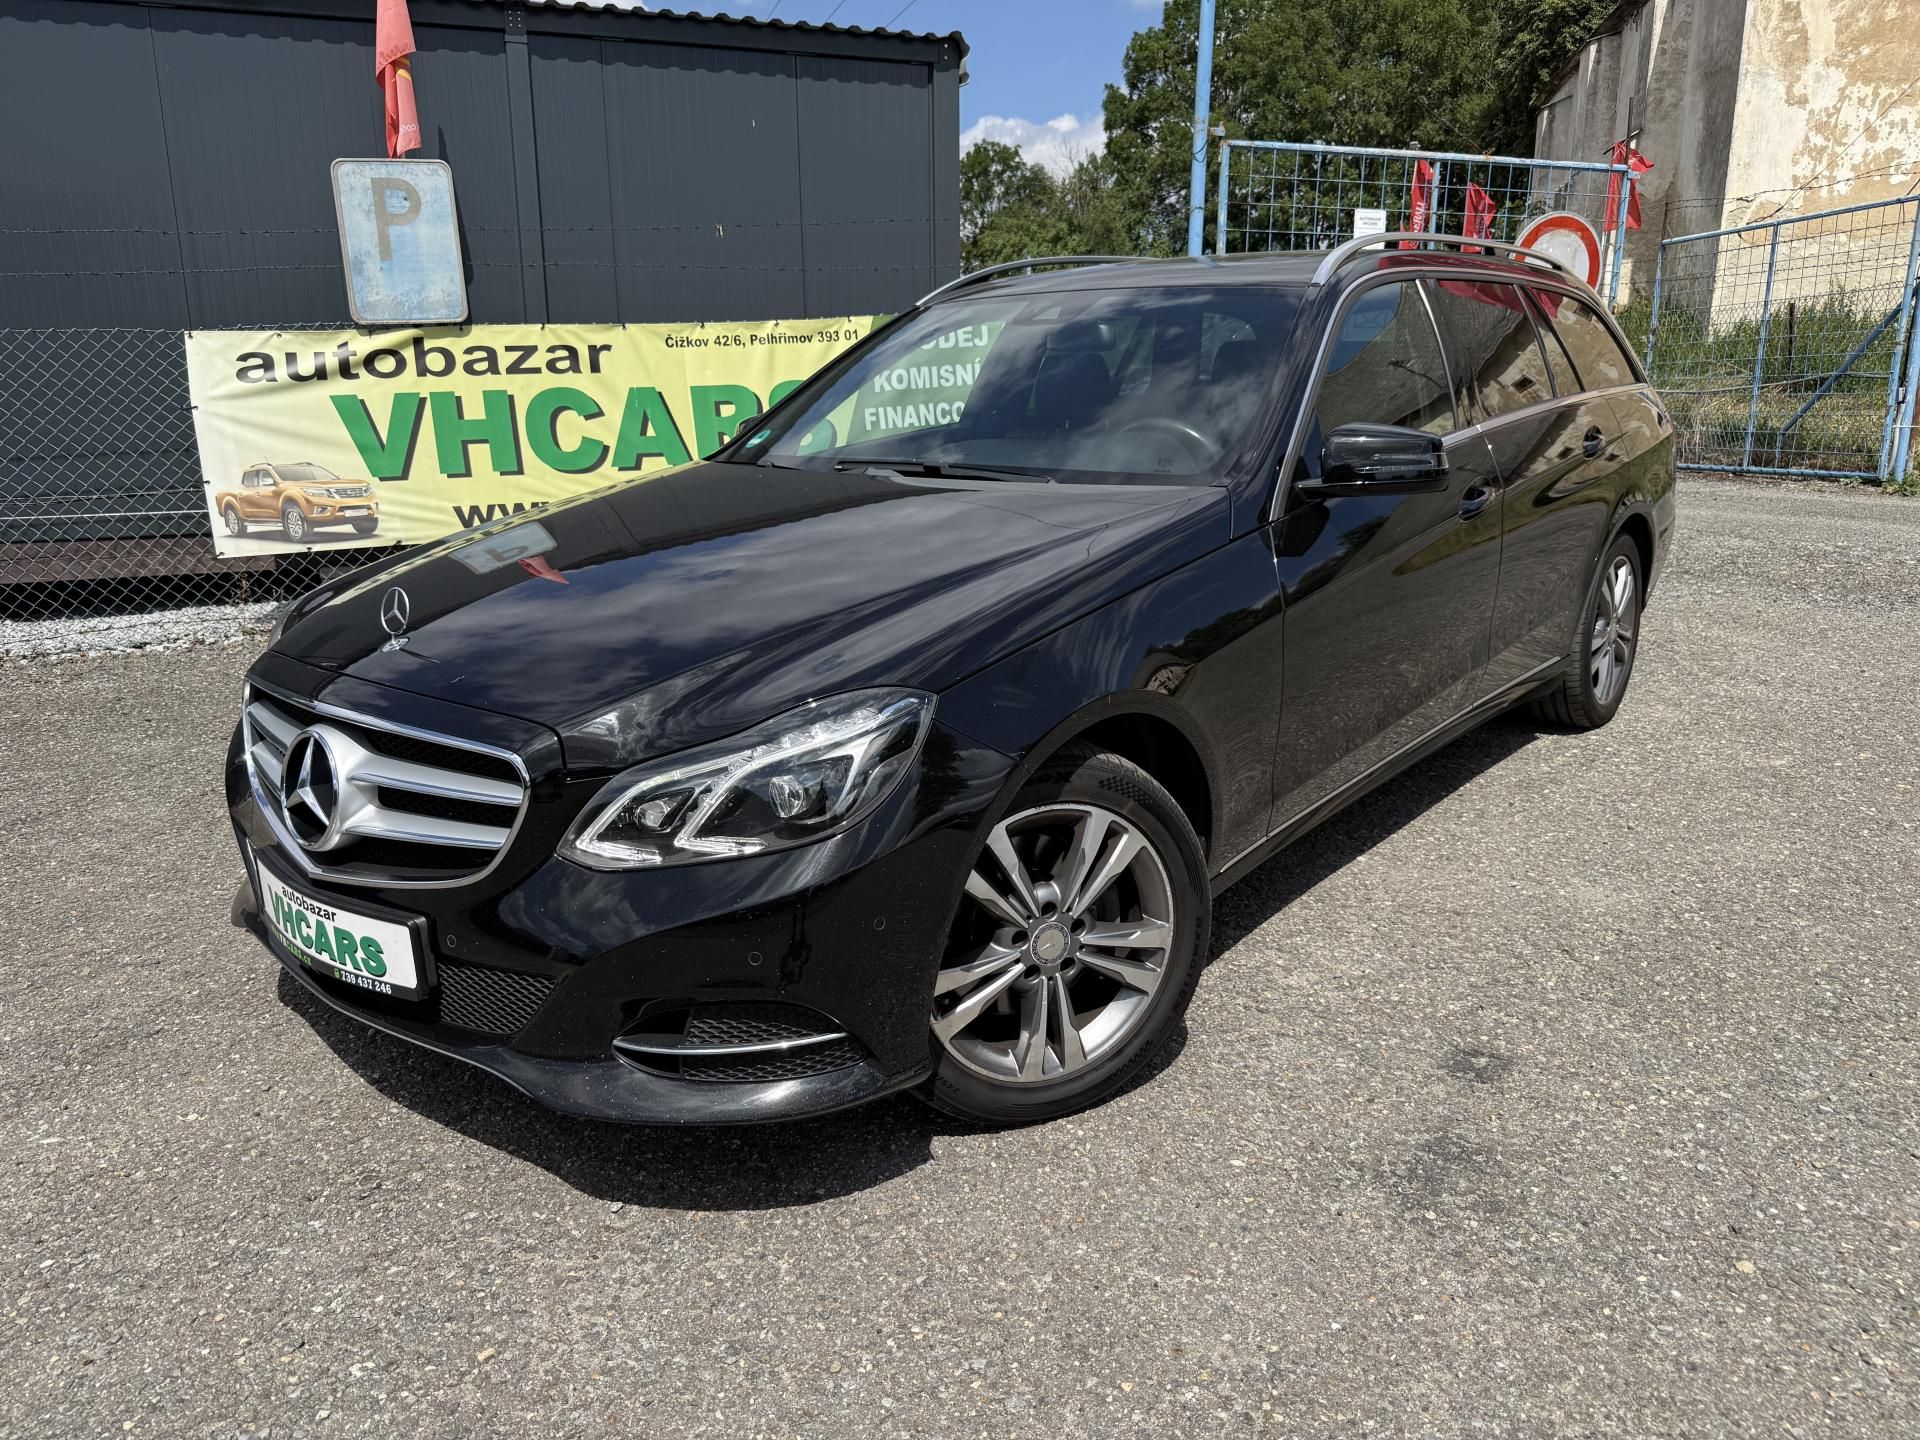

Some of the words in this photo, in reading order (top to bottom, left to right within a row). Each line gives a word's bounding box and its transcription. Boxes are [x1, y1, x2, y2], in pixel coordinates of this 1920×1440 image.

[371, 177, 422, 262] P
[665, 333, 709, 348] Čížkov
[713, 334, 746, 348] 42/6,
[750, 332, 813, 346] Pelhřimov
[817, 330, 840, 343] 393
[844, 329, 859, 341] 01
[235, 337, 613, 383] autobazar
[873, 357, 981, 393] KOMISNÍ
[282, 886, 337, 922] autobazar
[267, 883, 388, 978] VHCARS
[341, 971, 356, 984] 739
[357, 976, 373, 989] 437
[374, 981, 392, 994] 246
